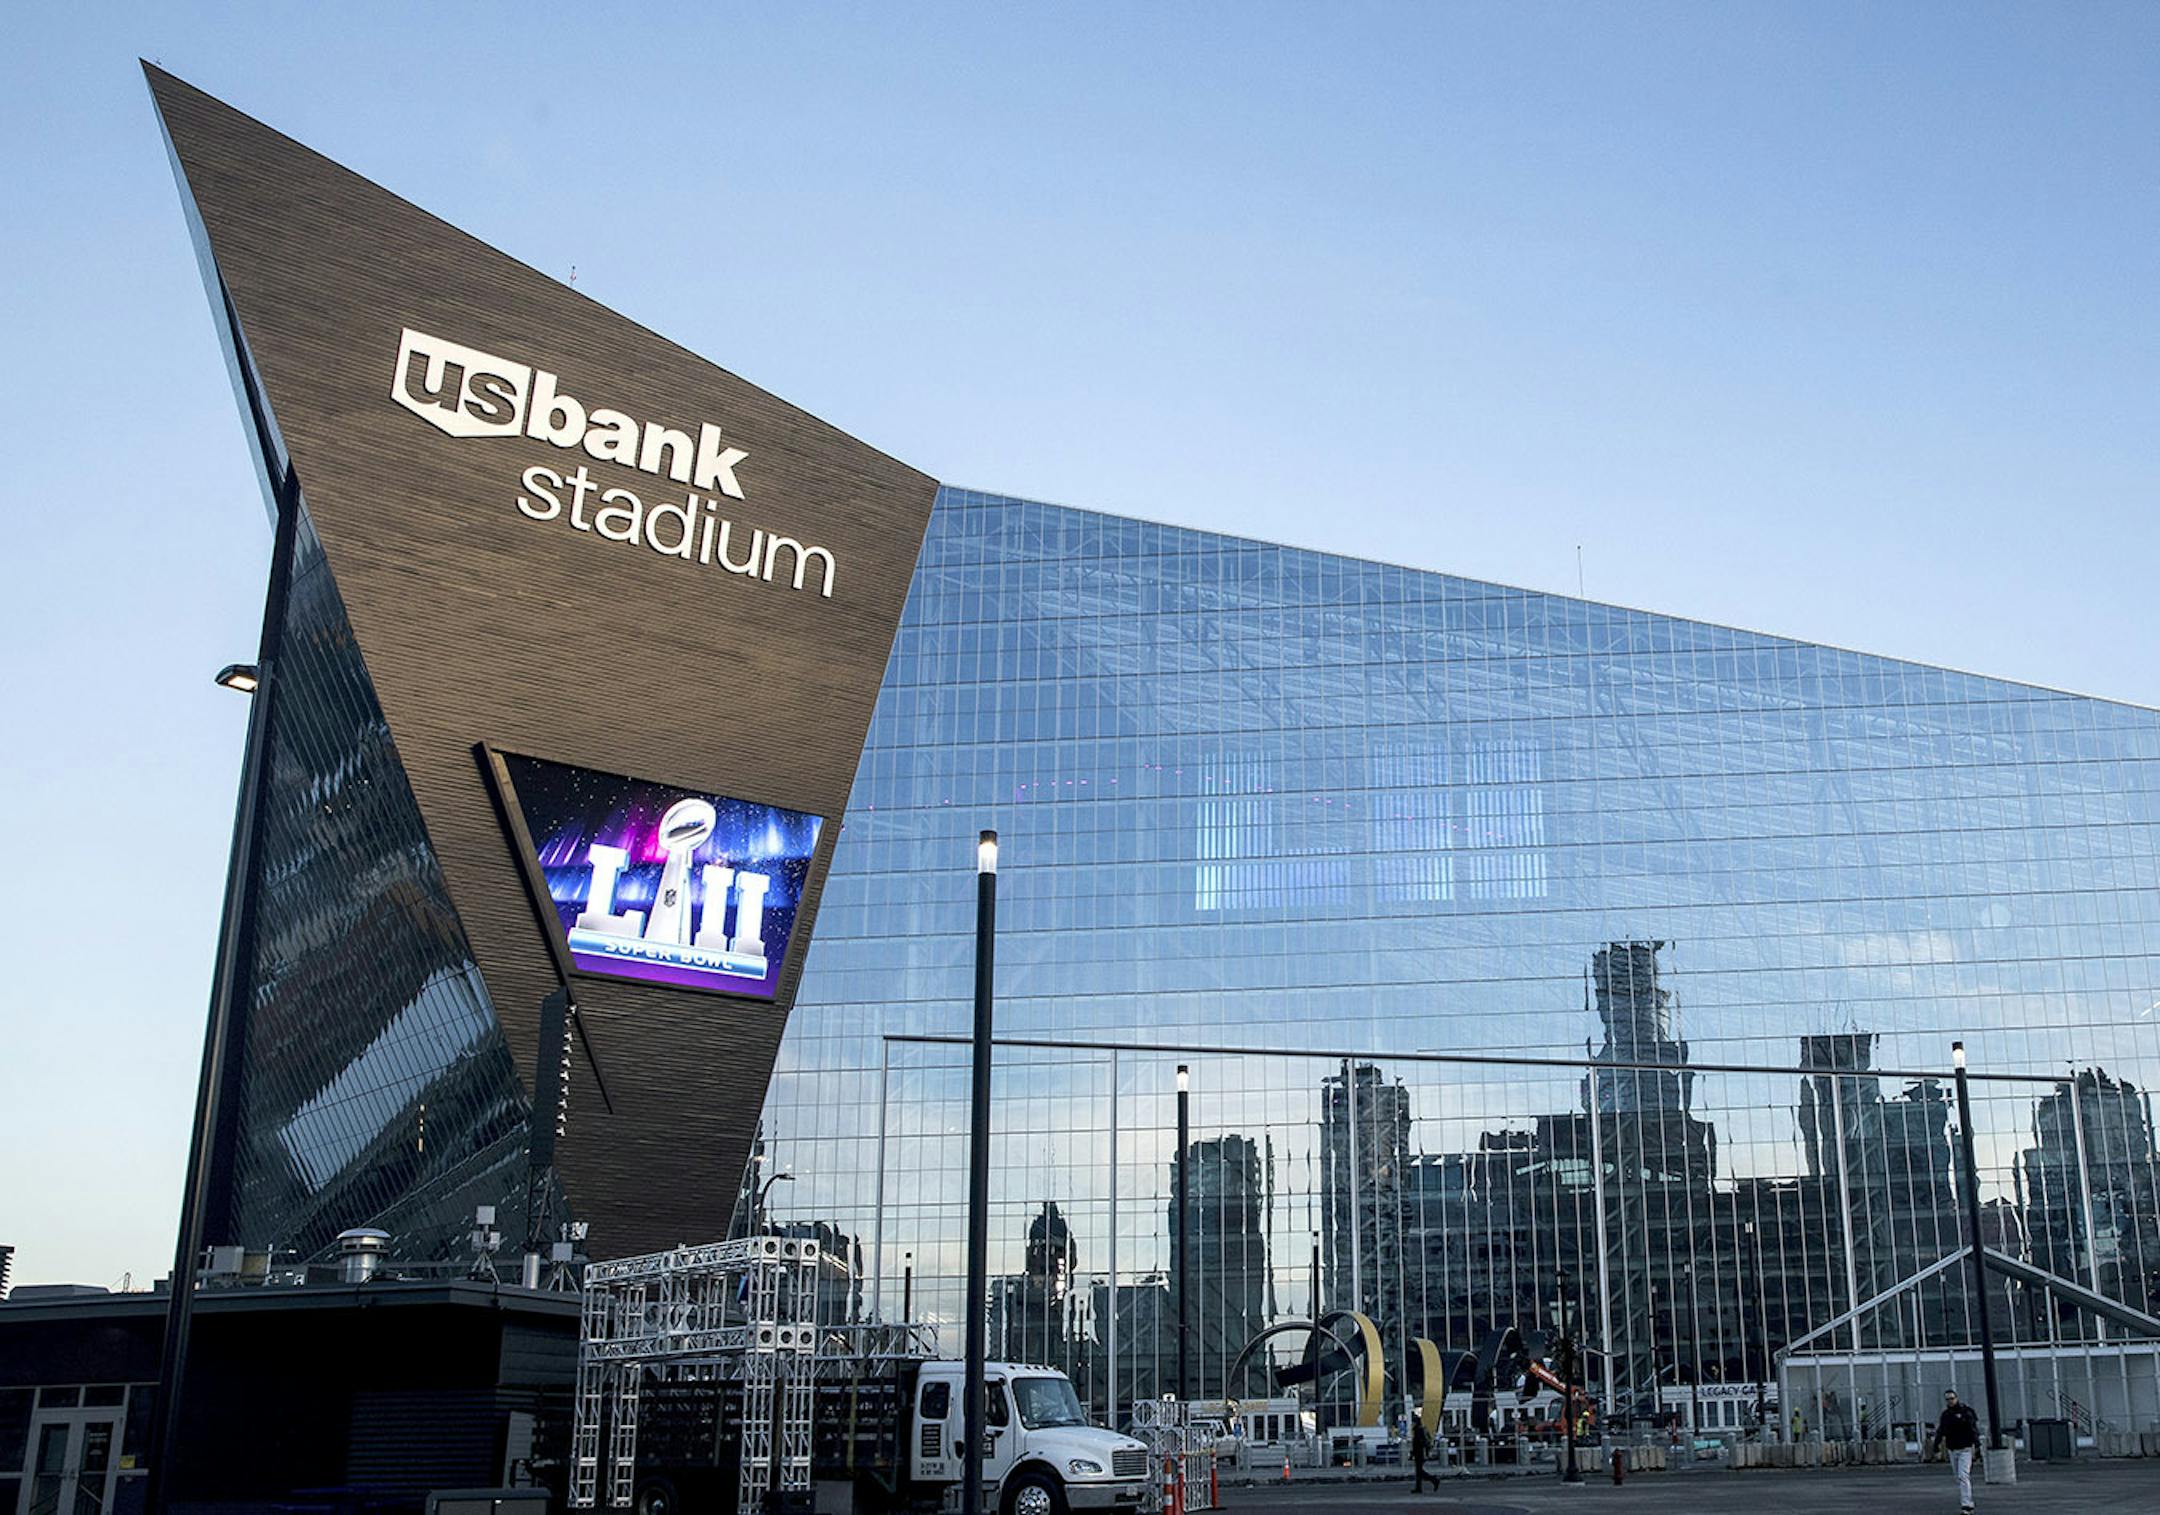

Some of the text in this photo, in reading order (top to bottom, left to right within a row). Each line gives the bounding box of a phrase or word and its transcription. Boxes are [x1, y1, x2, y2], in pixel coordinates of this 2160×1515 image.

[516, 465, 837, 599] stadium
[603, 941, 735, 971] SUPER BOWL
[1701, 1385, 1740, 1398] LEGACY
